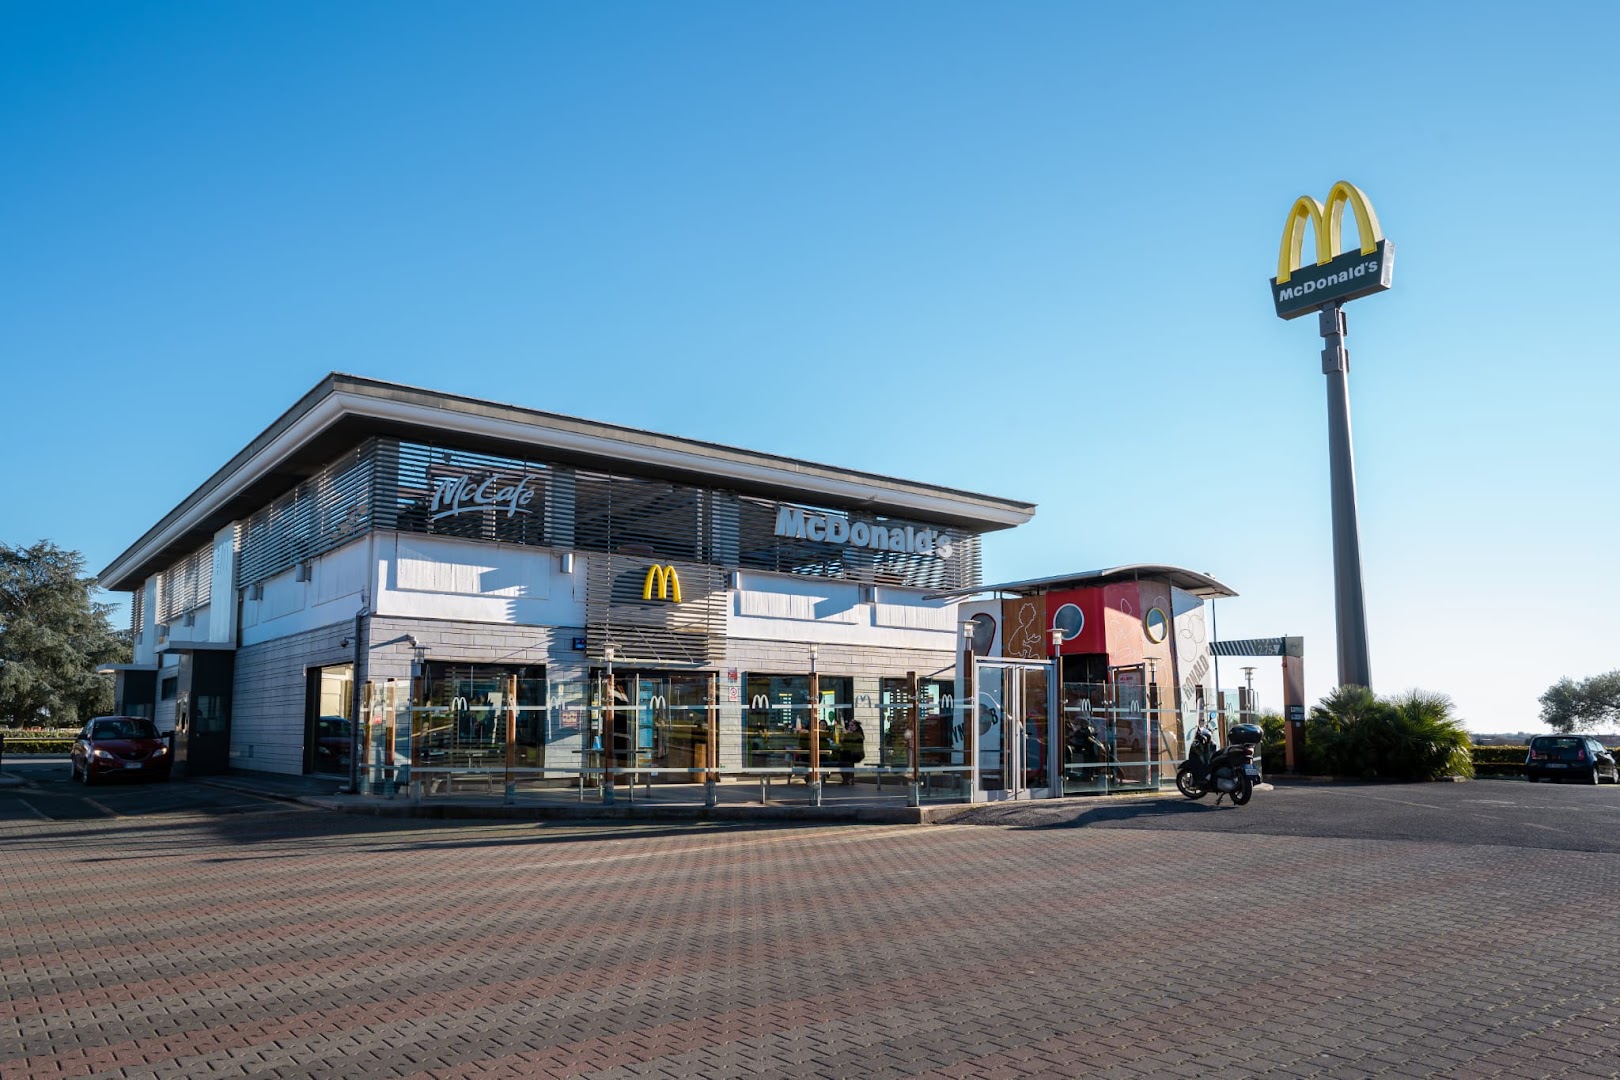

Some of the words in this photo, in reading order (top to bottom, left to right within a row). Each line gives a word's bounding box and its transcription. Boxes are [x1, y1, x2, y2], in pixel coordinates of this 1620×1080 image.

[1279, 260, 1378, 302] McDonald's
[431, 475, 535, 518] McCafé
[774, 506, 952, 558] McDonald's
[1182, 654, 1210, 700] RONALD
